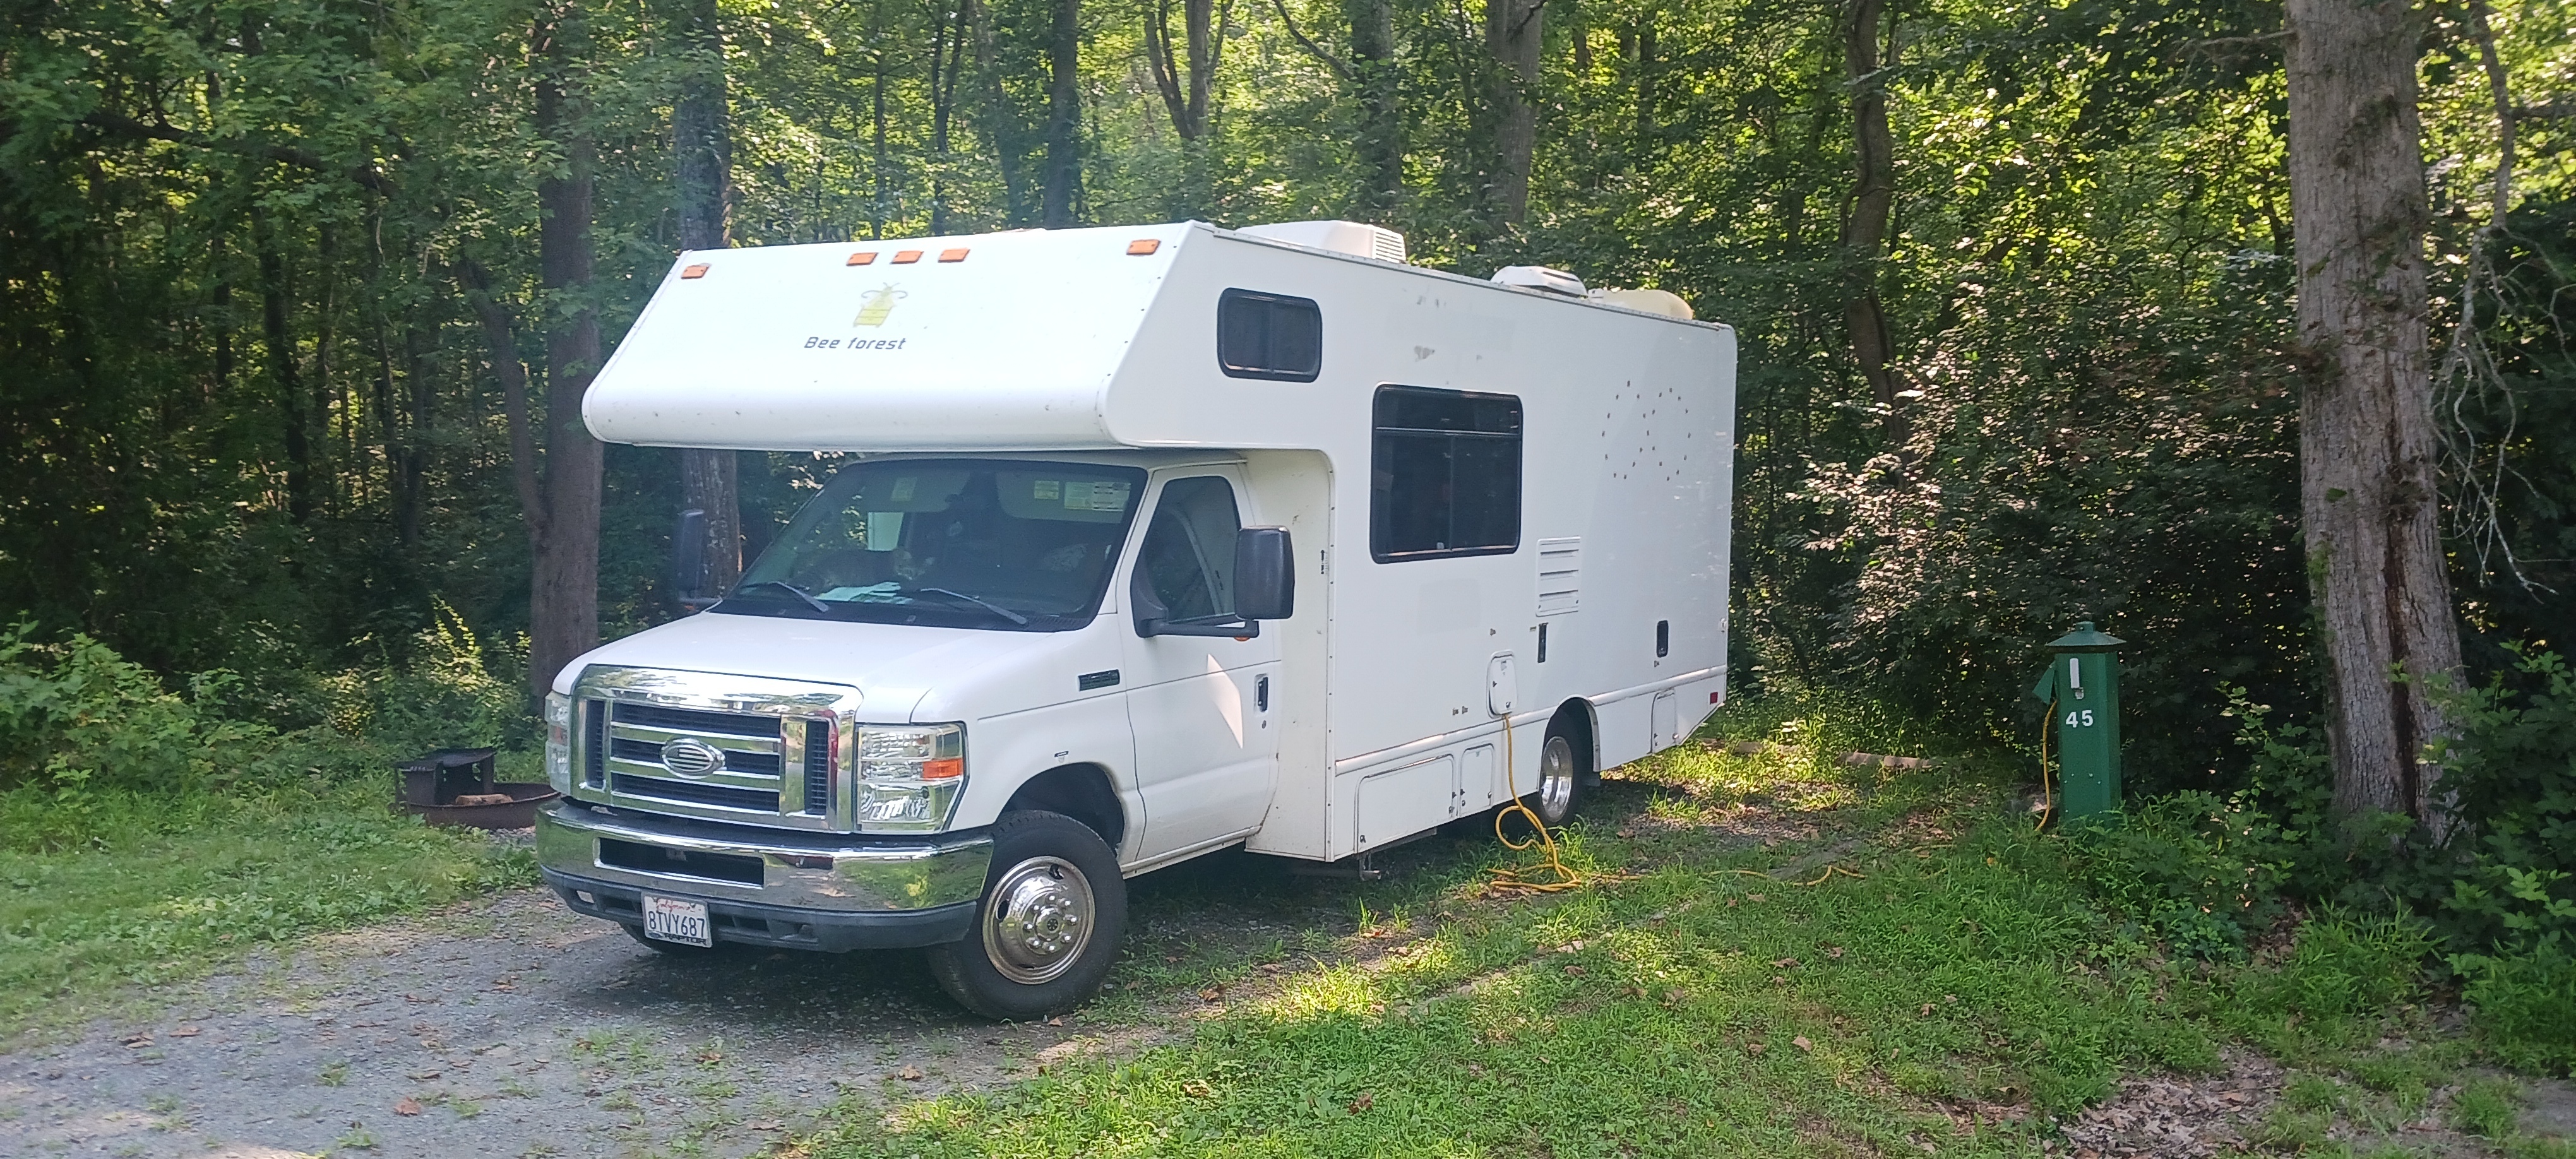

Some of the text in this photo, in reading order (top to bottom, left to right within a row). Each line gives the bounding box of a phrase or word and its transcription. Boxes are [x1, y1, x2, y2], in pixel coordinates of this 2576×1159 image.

[804, 336, 907, 350] Bee forest
[2066, 710, 2094, 728] 45
[648, 911, 705, 937] 8TVY687
[664, 933, 707, 945] RAPTOR
